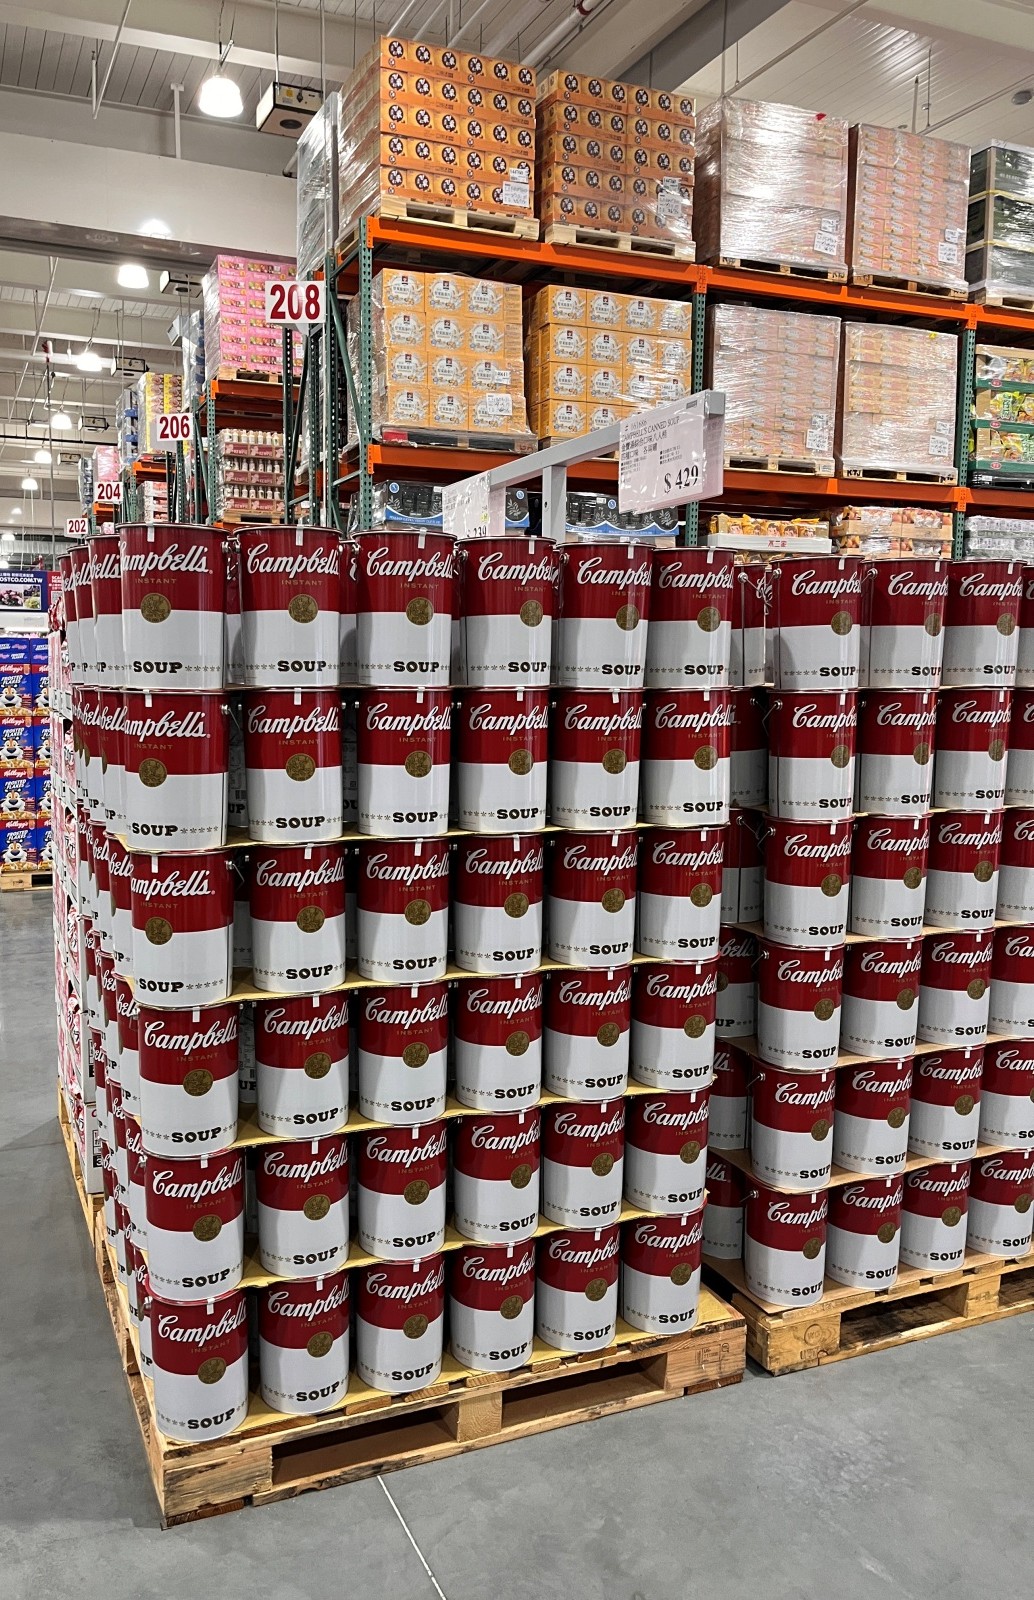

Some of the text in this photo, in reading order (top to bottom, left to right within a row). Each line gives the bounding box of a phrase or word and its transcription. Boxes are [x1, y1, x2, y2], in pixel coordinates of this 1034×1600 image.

[270, 284, 320, 320] 208
[160, 416, 190, 438] 206
[648, 421, 667, 433] CANNED
[675, 465, 698, 489] 429
[98, 484, 120, 500] 204
[68, 520, 86, 532] 202
[120, 544, 209, 578] ampbell's
[133, 661, 182, 673] SOUP
[277, 661, 326, 672] SOUP
[393, 661, 439, 673] SOUP
[508, 662, 547, 672] SOUP
[602, 664, 640, 675] SOUP
[685, 665, 723, 675] SOUP
[819, 667, 855, 676] SOUP
[125, 708, 207, 741] ampbell's
[590, 805, 630, 817] SOUP
[683, 801, 723, 812] SOUP
[393, 812, 438, 823] SOUP
[496, 808, 539, 819] SOUP
[275, 816, 325, 828] SOUP
[132, 823, 177, 836] SOUP
[132, 871, 213, 900] ampbell's
[961, 909, 994, 918] SOUP
[891, 916, 922, 927] SOUP
[809, 925, 844, 935] SOUP
[589, 943, 628, 954] SOUP
[678, 937, 715, 948] SOUP
[493, 949, 535, 961] SOUP
[393, 957, 437, 970] SOUP
[286, 965, 333, 979] SOUP
[139, 978, 184, 992] SOUP
[955, 1025, 986, 1035] SOUP
[885, 1036, 916, 1047] SOUP
[802, 1048, 836, 1059] SOUP
[672, 1066, 710, 1078] SOUP
[585, 1075, 624, 1088] SOUP
[494, 1085, 535, 1098] SOUP
[391, 1098, 435, 1111] SOUP
[294, 1108, 338, 1125] SOUP
[172, 1127, 221, 1143] SOUP
[942, 1139, 975, 1151] SOUP
[875, 1153, 906, 1165] SOUP
[800, 1165, 830, 1179] SOUP
[668, 1188, 703, 1202] SOUP
[579, 1202, 617, 1217] SOUP
[500, 1213, 536, 1231] SOUP
[393, 1232, 436, 1248] SOUP
[293, 1247, 339, 1265] SOUP
[930, 1249, 963, 1262] SOUP
[182, 1269, 230, 1288] SOUP
[866, 1266, 897, 1279] SOUP
[792, 1281, 822, 1296] SOUP
[658, 1309, 695, 1324] SOUP
[573, 1325, 611, 1341] SOUP
[489, 1343, 528, 1361] SOUP
[391, 1363, 434, 1380] SOUP
[296, 1383, 340, 1402] SOUP
[187, 1409, 235, 1429] SOUP
